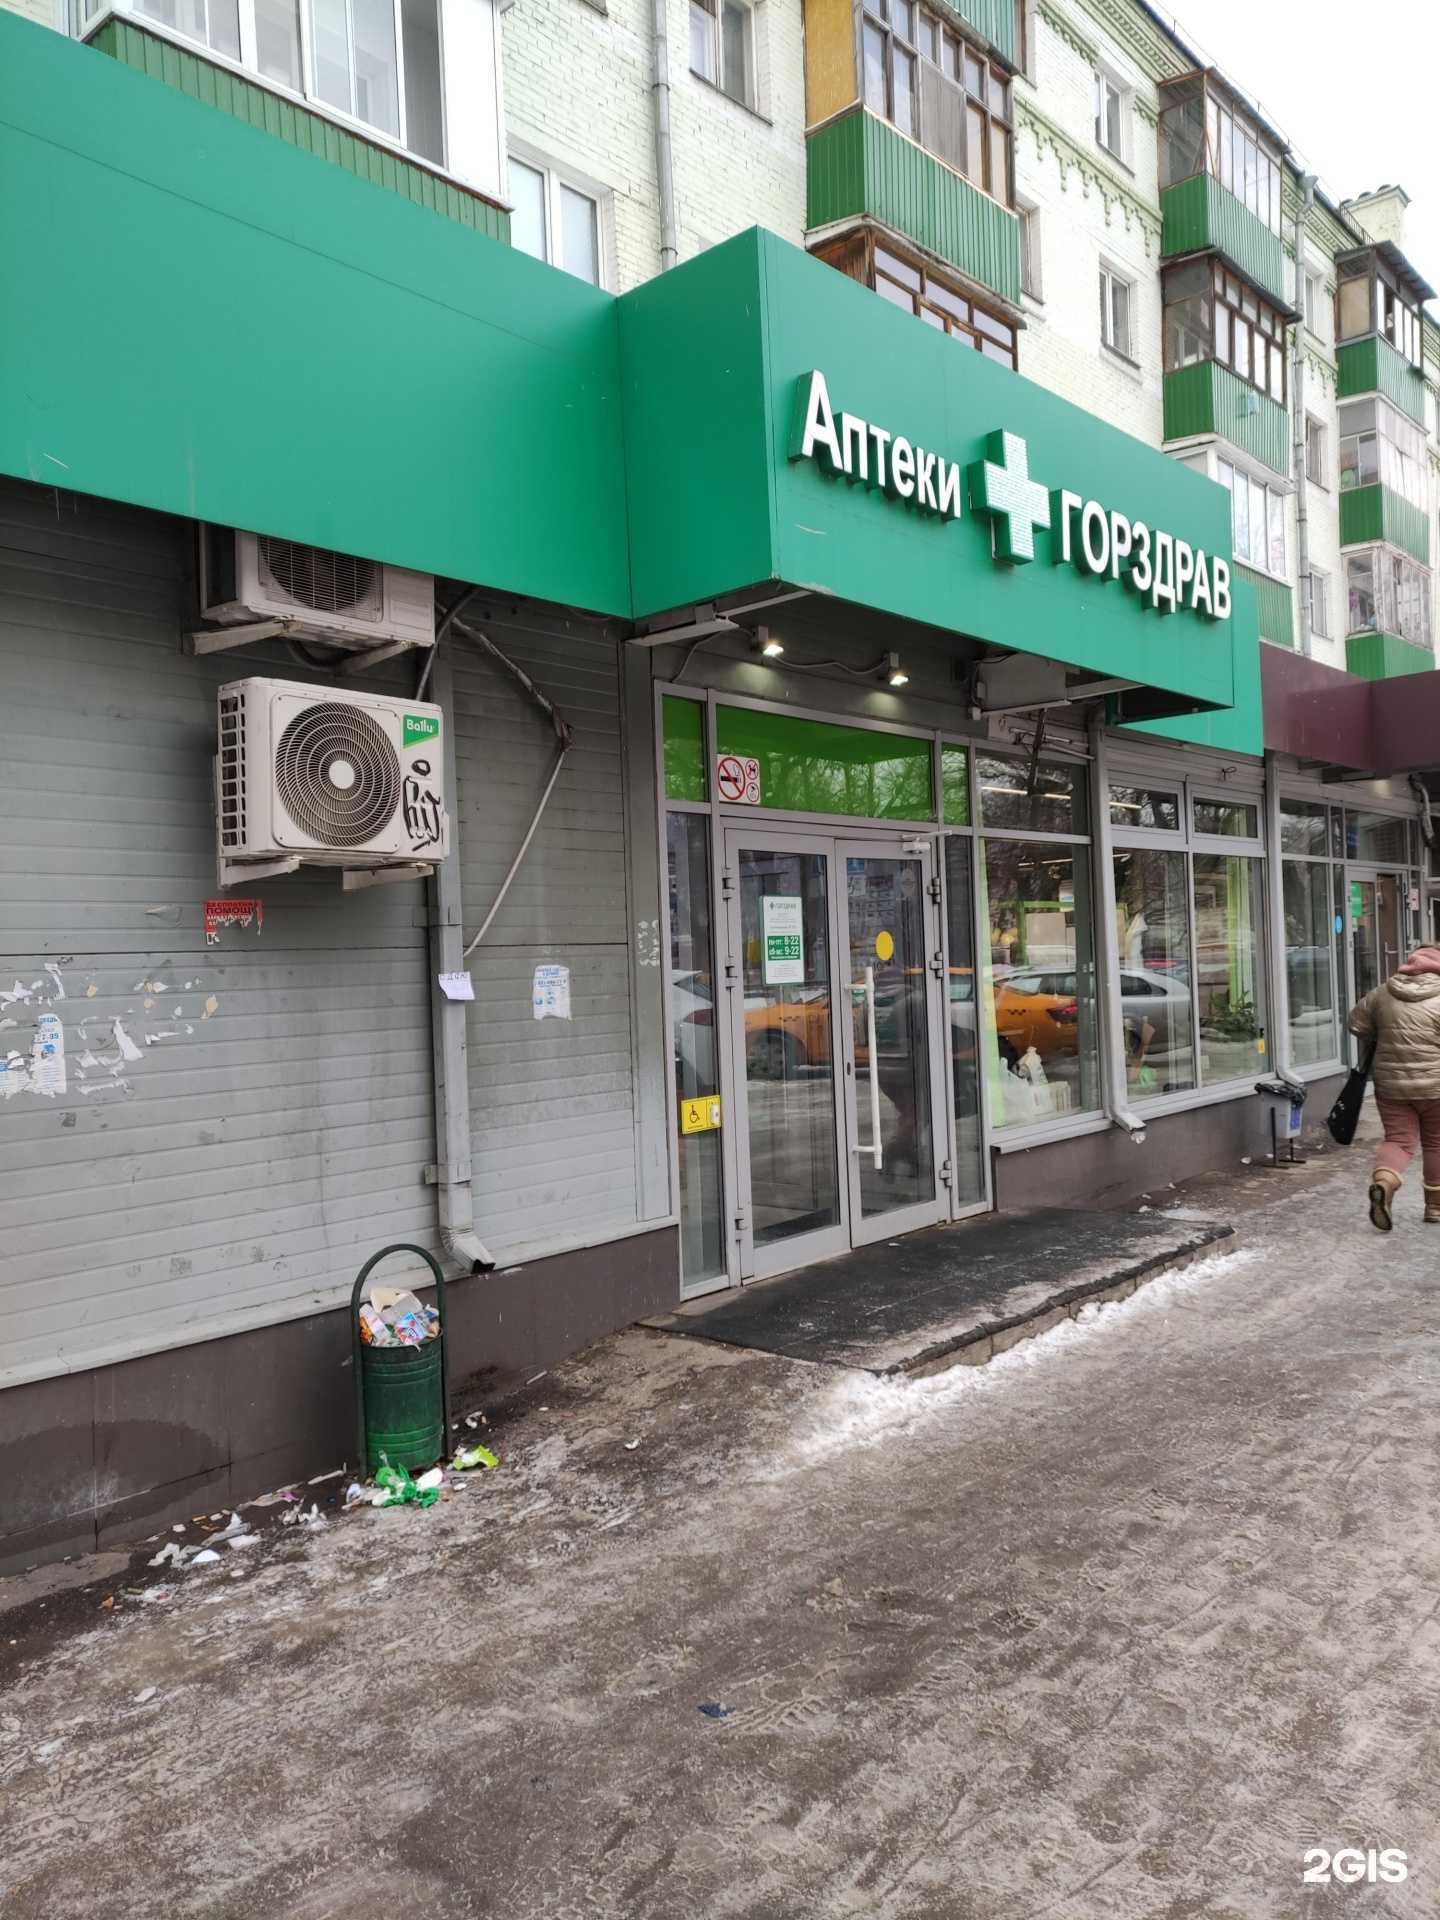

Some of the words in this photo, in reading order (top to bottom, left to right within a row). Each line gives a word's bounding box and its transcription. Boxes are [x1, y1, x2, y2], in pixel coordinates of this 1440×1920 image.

[800, 368, 962, 520] Аптеки
[1061, 488, 1232, 620] ГОРЗДРАВ
[407, 719, 433, 733] Ballu
